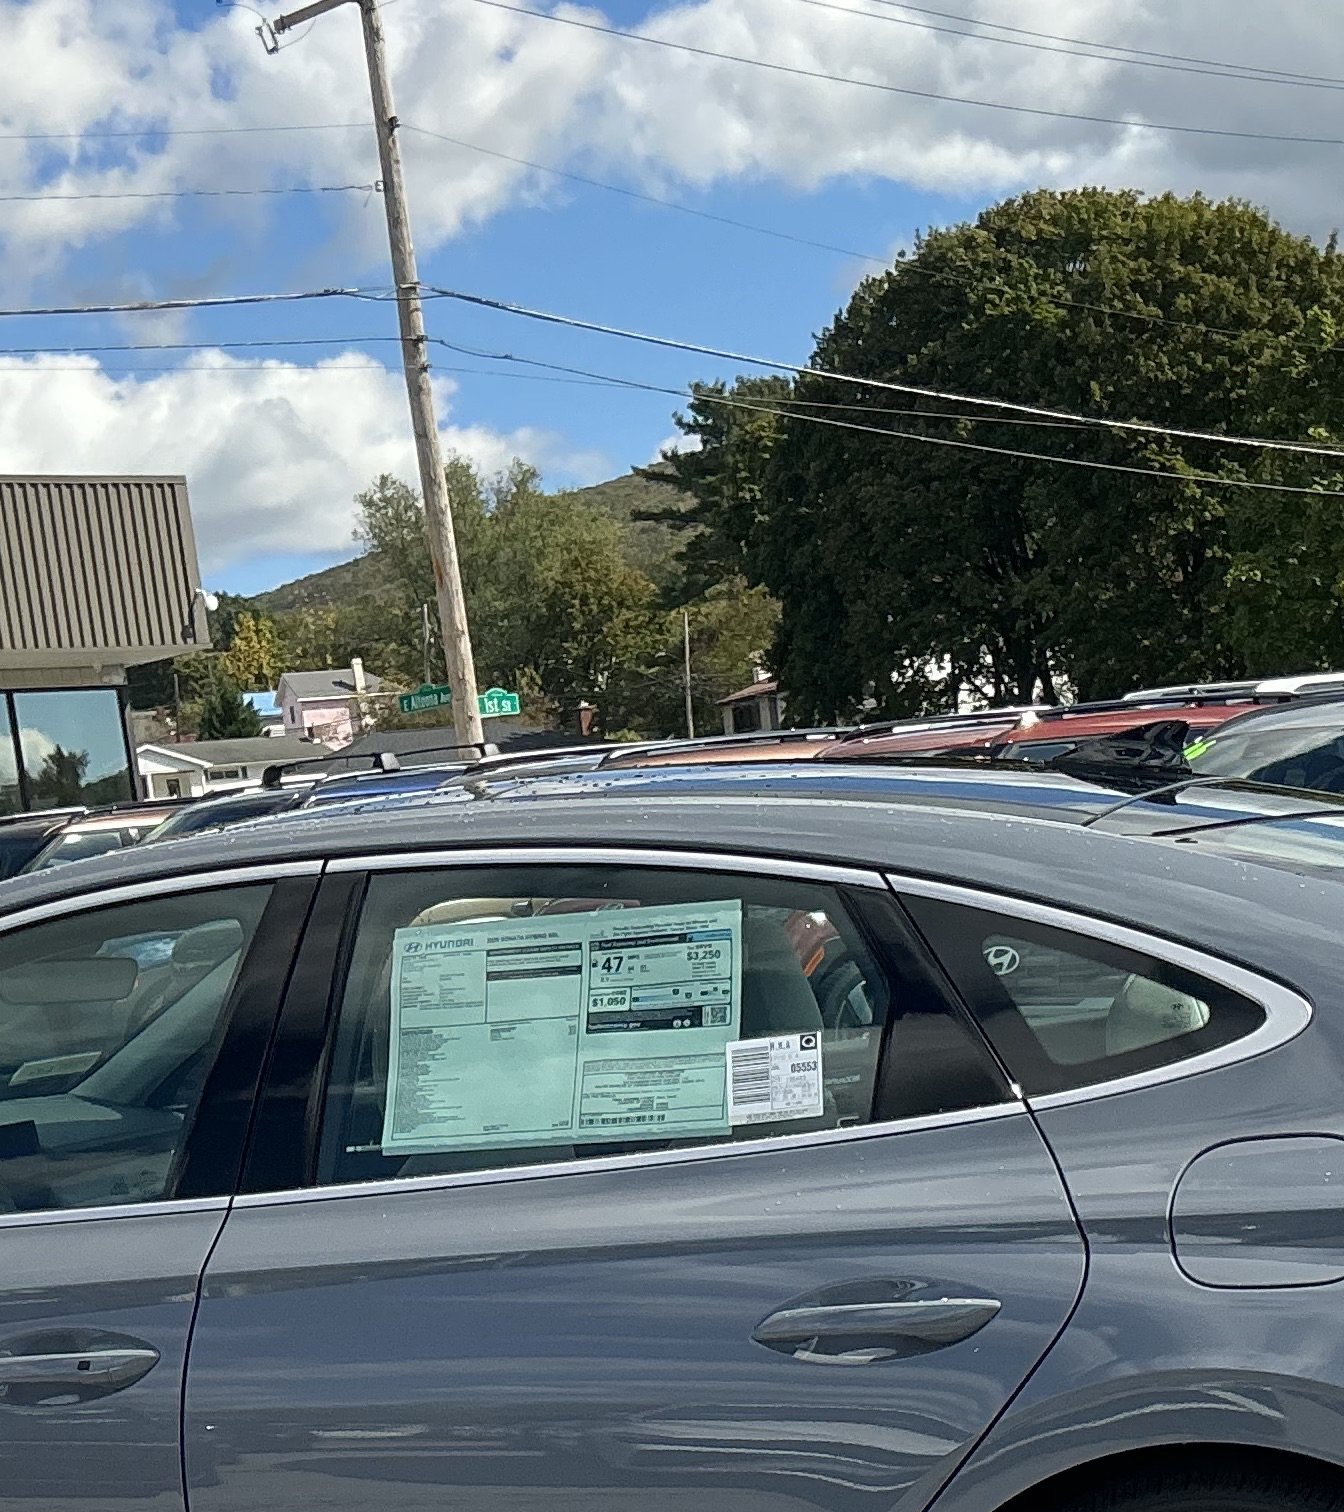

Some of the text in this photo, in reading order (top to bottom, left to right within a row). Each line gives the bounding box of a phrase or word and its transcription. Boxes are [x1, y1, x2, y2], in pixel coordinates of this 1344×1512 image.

[425, 938, 474, 950] HYUNDAI
[686, 949, 721, 961] $3,250
[601, 956, 623, 972] 47
[592, 997, 626, 1007] $1,050
